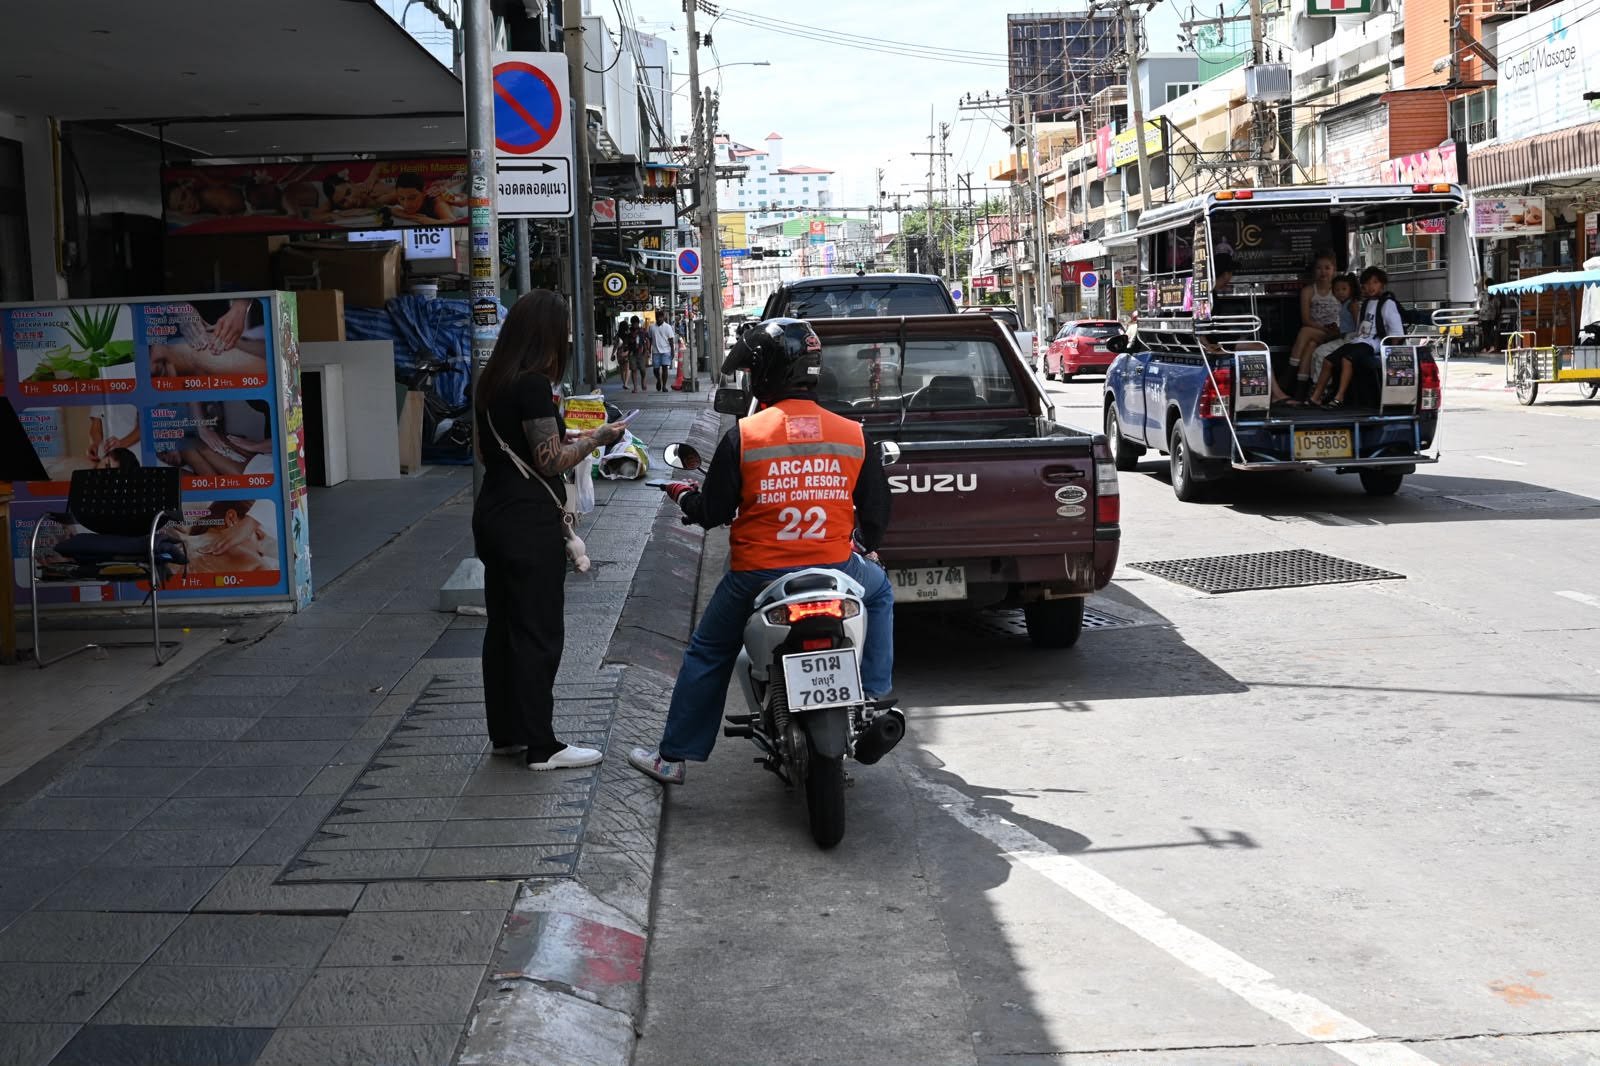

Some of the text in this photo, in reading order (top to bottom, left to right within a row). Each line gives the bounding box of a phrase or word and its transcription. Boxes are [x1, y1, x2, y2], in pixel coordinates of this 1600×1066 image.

[1535, 45, 1576, 69] Massage
[498, 182, 567, 197] จอดตลอดแนว
[37, 310, 54, 318] Sun
[144, 304, 193, 315] Body Scrub
[24, 385, 28, 393] 1
[52, 383, 75, 393] 500.-
[87, 383, 102, 391] Hrs.
[110, 381, 133, 390] 900.-
[156, 376, 265, 388] 1 Hr. 500.- 2 Hrs. 900.-
[34, 414, 51, 423] Spa
[151, 408, 177, 418] Milky
[768, 458, 841, 476] ARCADIA
[191, 476, 271, 488] 500.- 2 Hrs. 900.-
[760, 475, 847, 491] BEACH RESORT
[888, 473, 977, 494] SUZU
[790, 489, 849, 502] CONTINENTAL
[183, 509, 211, 517] assage
[776, 506, 827, 541] 22
[190, 577, 202, 586] Hr.
[222, 575, 244, 585] 00.-
[811, 673, 835, 687] ชลบุรี
[799, 686, 851, 706] 7038
